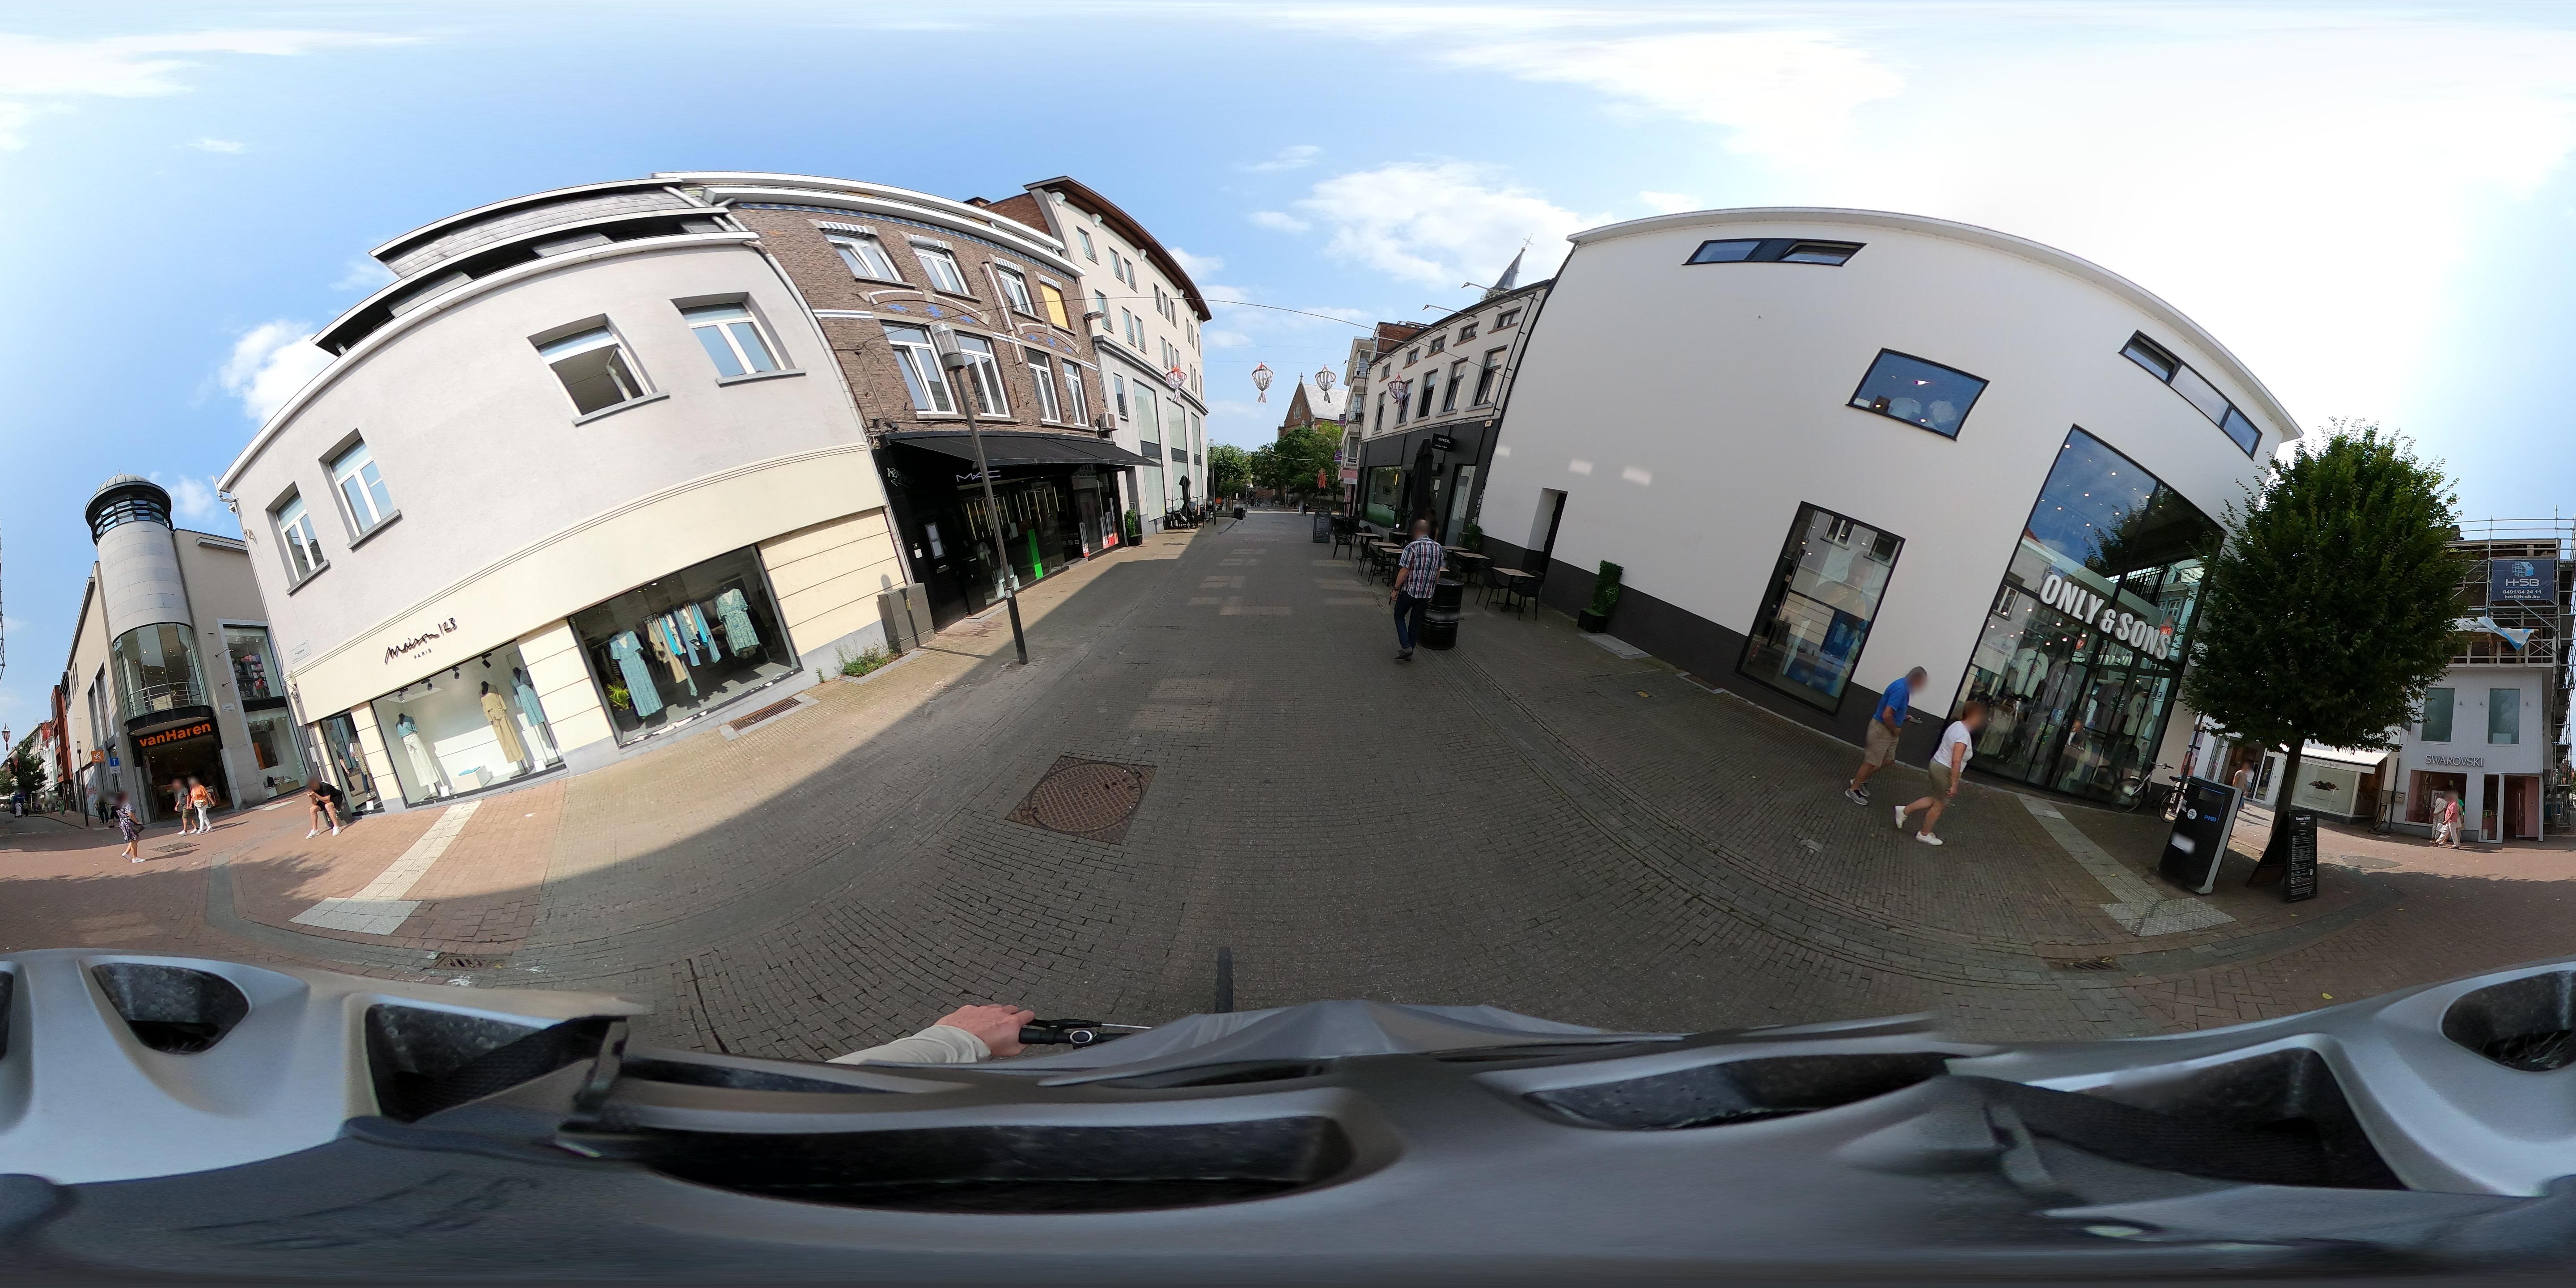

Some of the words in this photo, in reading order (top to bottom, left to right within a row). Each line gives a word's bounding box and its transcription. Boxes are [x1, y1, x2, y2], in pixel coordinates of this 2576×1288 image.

[2505, 578, 2539, 586] H-SB
[2040, 574, 2105, 624] ONLY
[2099, 609, 2116, 634] &
[2114, 613, 2171, 660] SONS
[385, 633, 440, 665] Maison
[438, 618, 458, 636] 123
[414, 648, 432, 660] PARIS
[140, 723, 211, 747] vanHaren
[2425, 755, 2483, 767] SWAROVSKI
